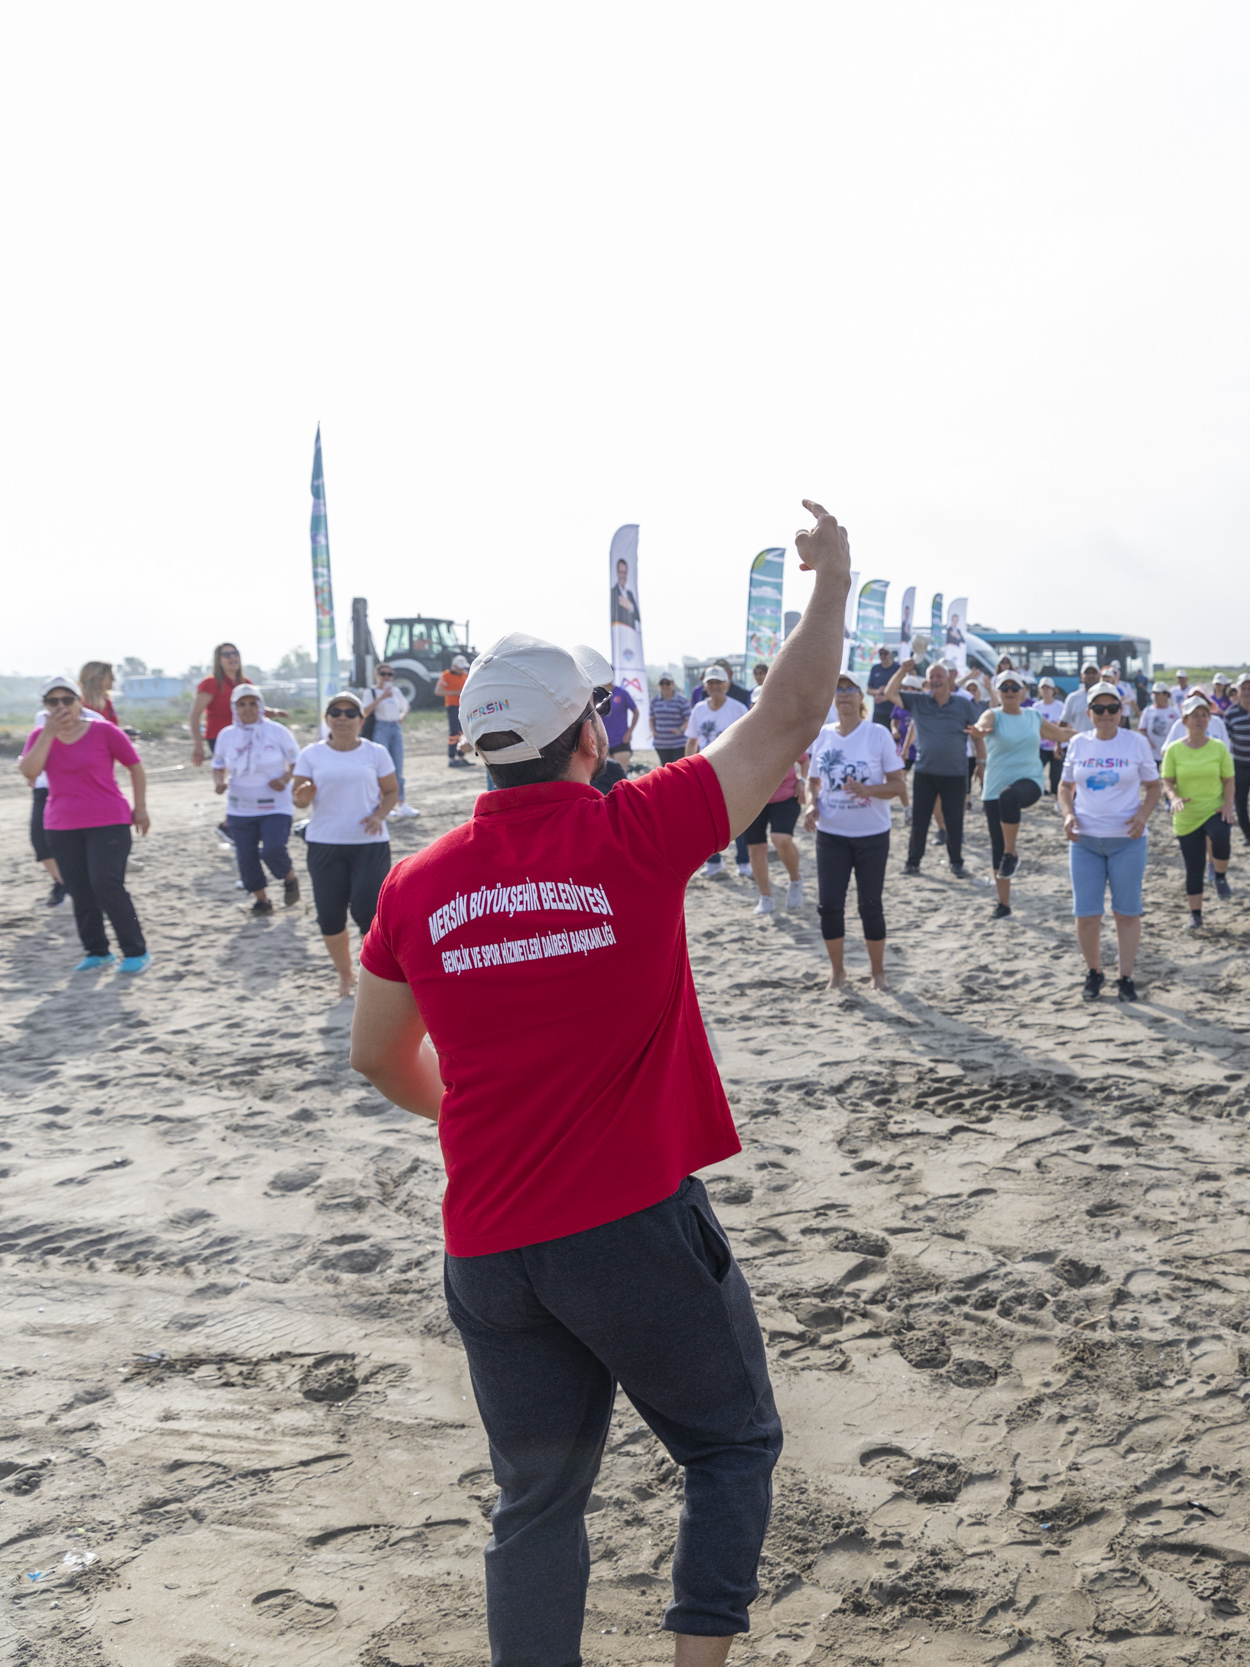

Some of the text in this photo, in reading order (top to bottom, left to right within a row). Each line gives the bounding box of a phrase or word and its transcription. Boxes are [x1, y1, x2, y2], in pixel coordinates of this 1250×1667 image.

[428, 876, 614, 945] MERSİN BÜYÜKŞEHİR BELEDİYESİ
[441, 921, 617, 975] GENÇLİK VE SPOR HİZMETLERİ DAİRESİ BAŞKANLIĞI
